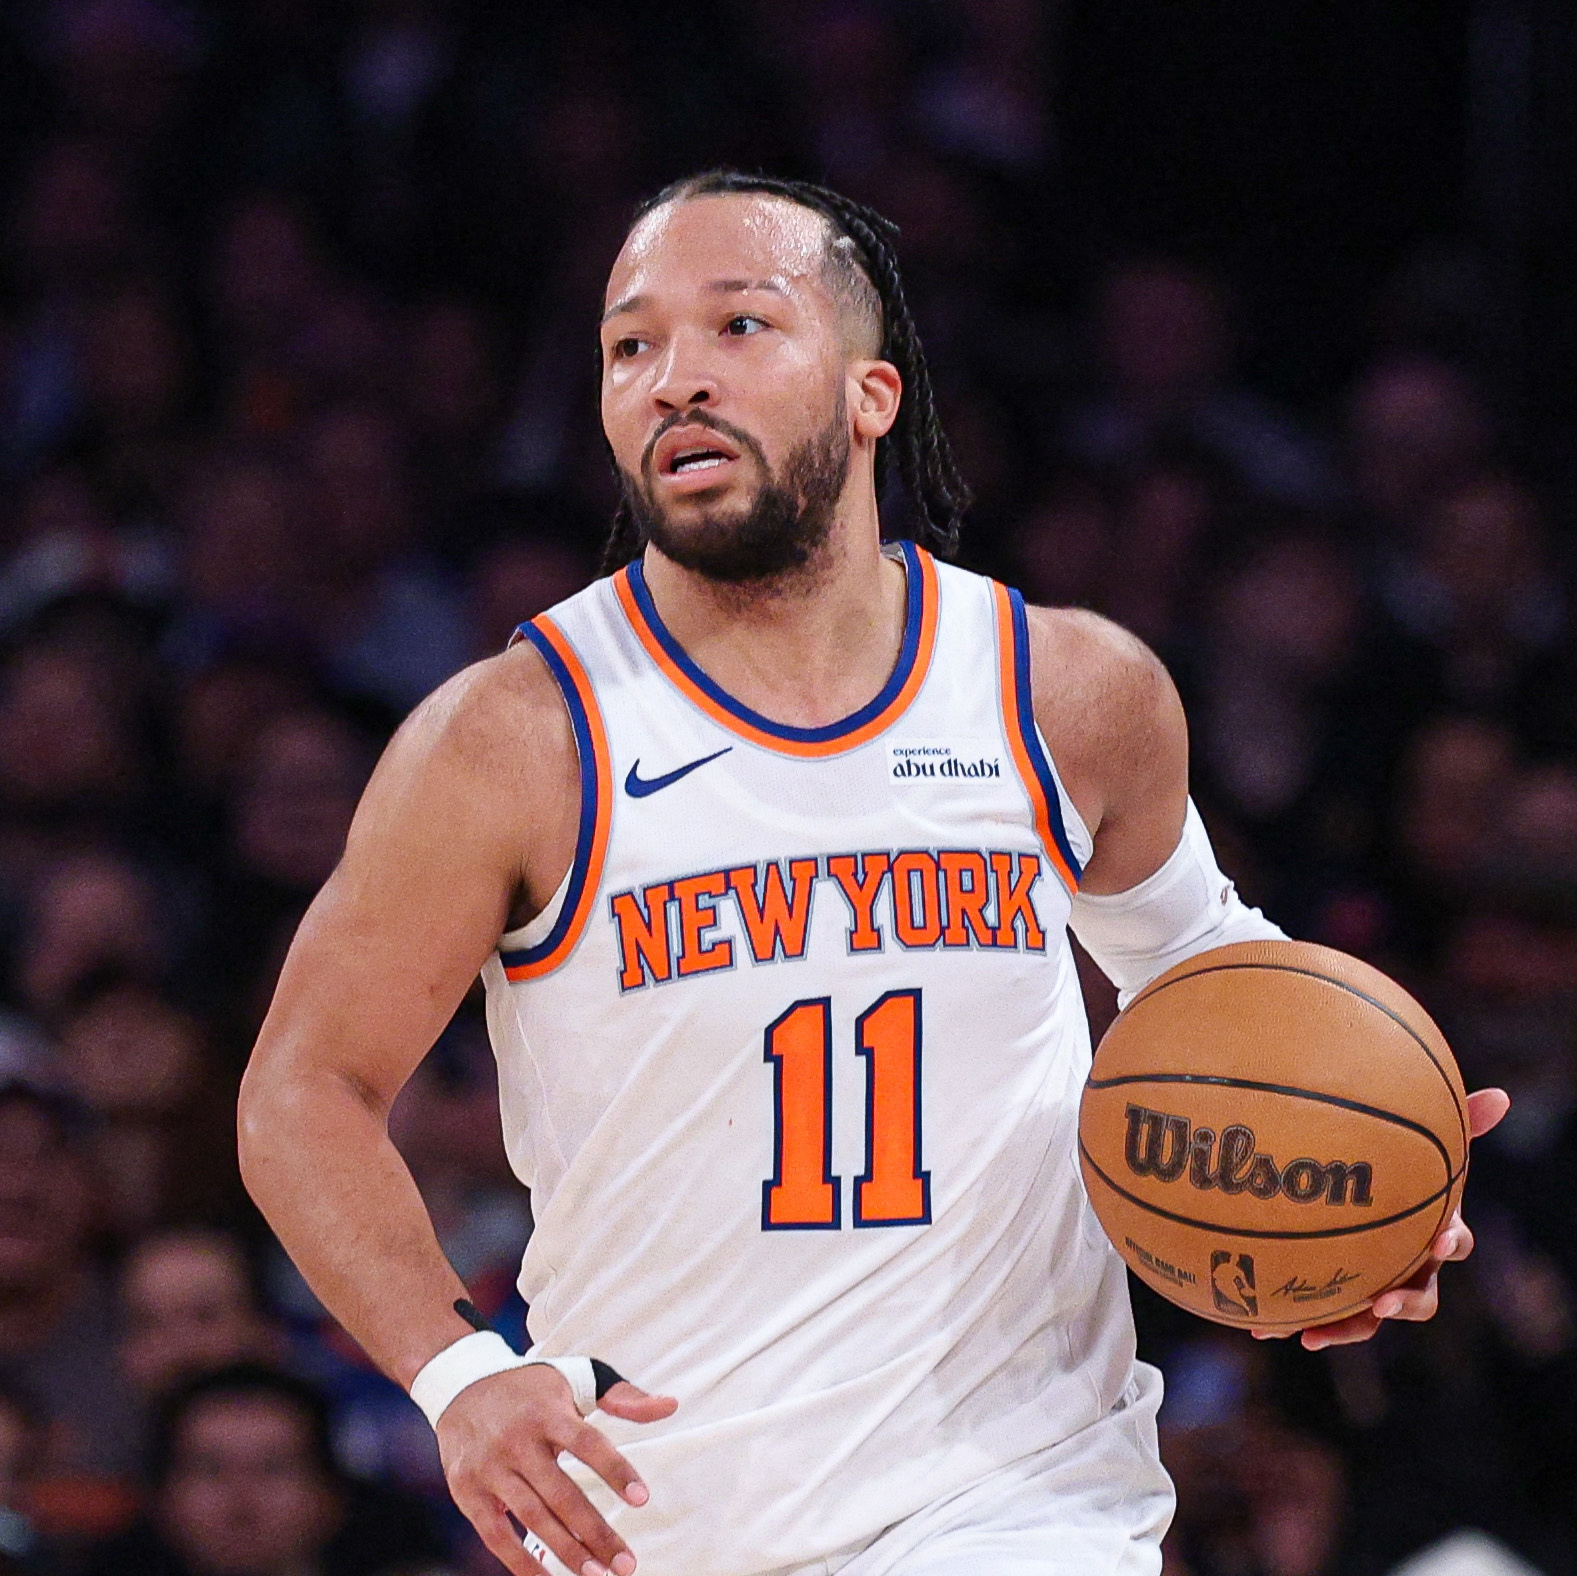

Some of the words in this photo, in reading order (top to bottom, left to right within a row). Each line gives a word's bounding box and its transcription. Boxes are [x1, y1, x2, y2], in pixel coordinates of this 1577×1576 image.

[893, 745, 951, 758] experience
[893, 758, 935, 778] abu
[609, 857, 820, 996] NEW
[826, 848, 1047, 957] YORK
[761, 988, 932, 1231] 11
[1125, 1102, 1374, 1207] Wilson
